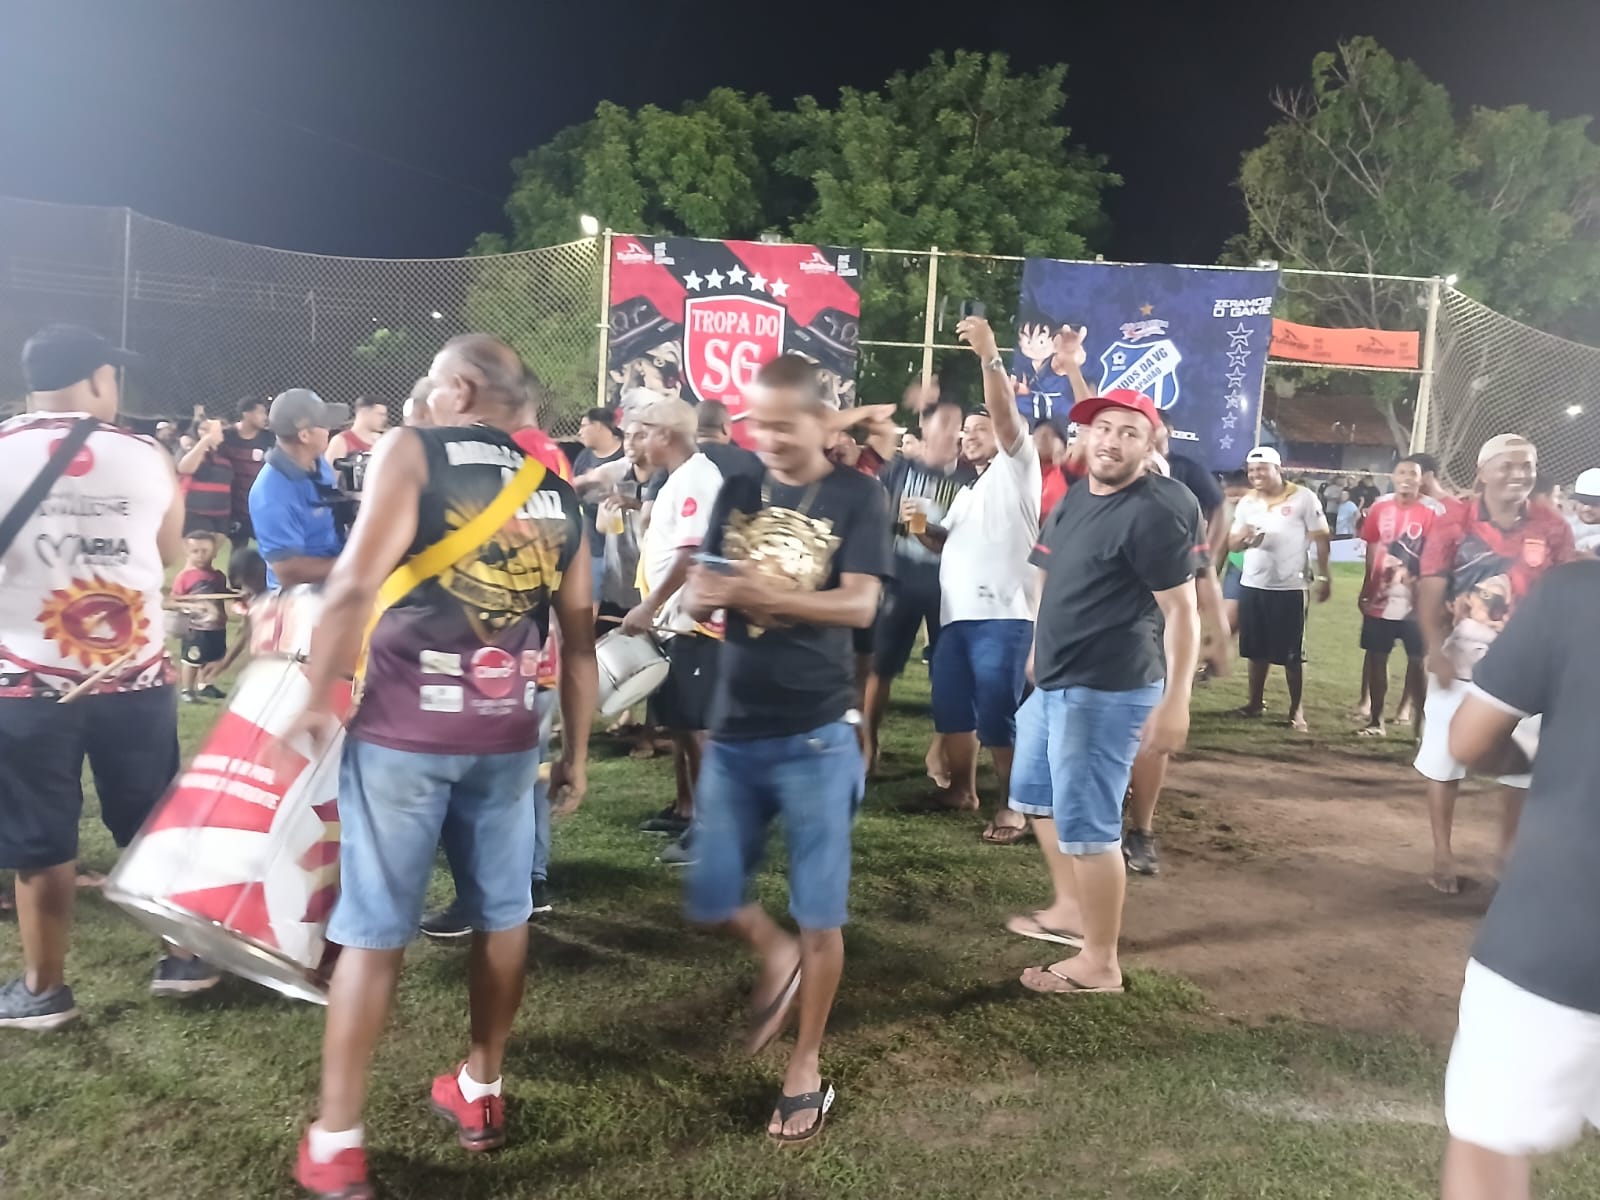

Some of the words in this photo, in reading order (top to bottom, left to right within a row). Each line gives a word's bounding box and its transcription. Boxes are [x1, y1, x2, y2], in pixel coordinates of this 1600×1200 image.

[1213, 307, 1225, 318] O
[1230, 306, 1271, 317] GAME
[1214, 296, 1272, 308] ZERAMOS
[691, 308, 750, 336] TROPA
[755, 313, 779, 338] DO
[701, 338, 763, 393] SG
[1140, 357, 1155, 373] DA
[1152, 347, 1169, 362] VG
